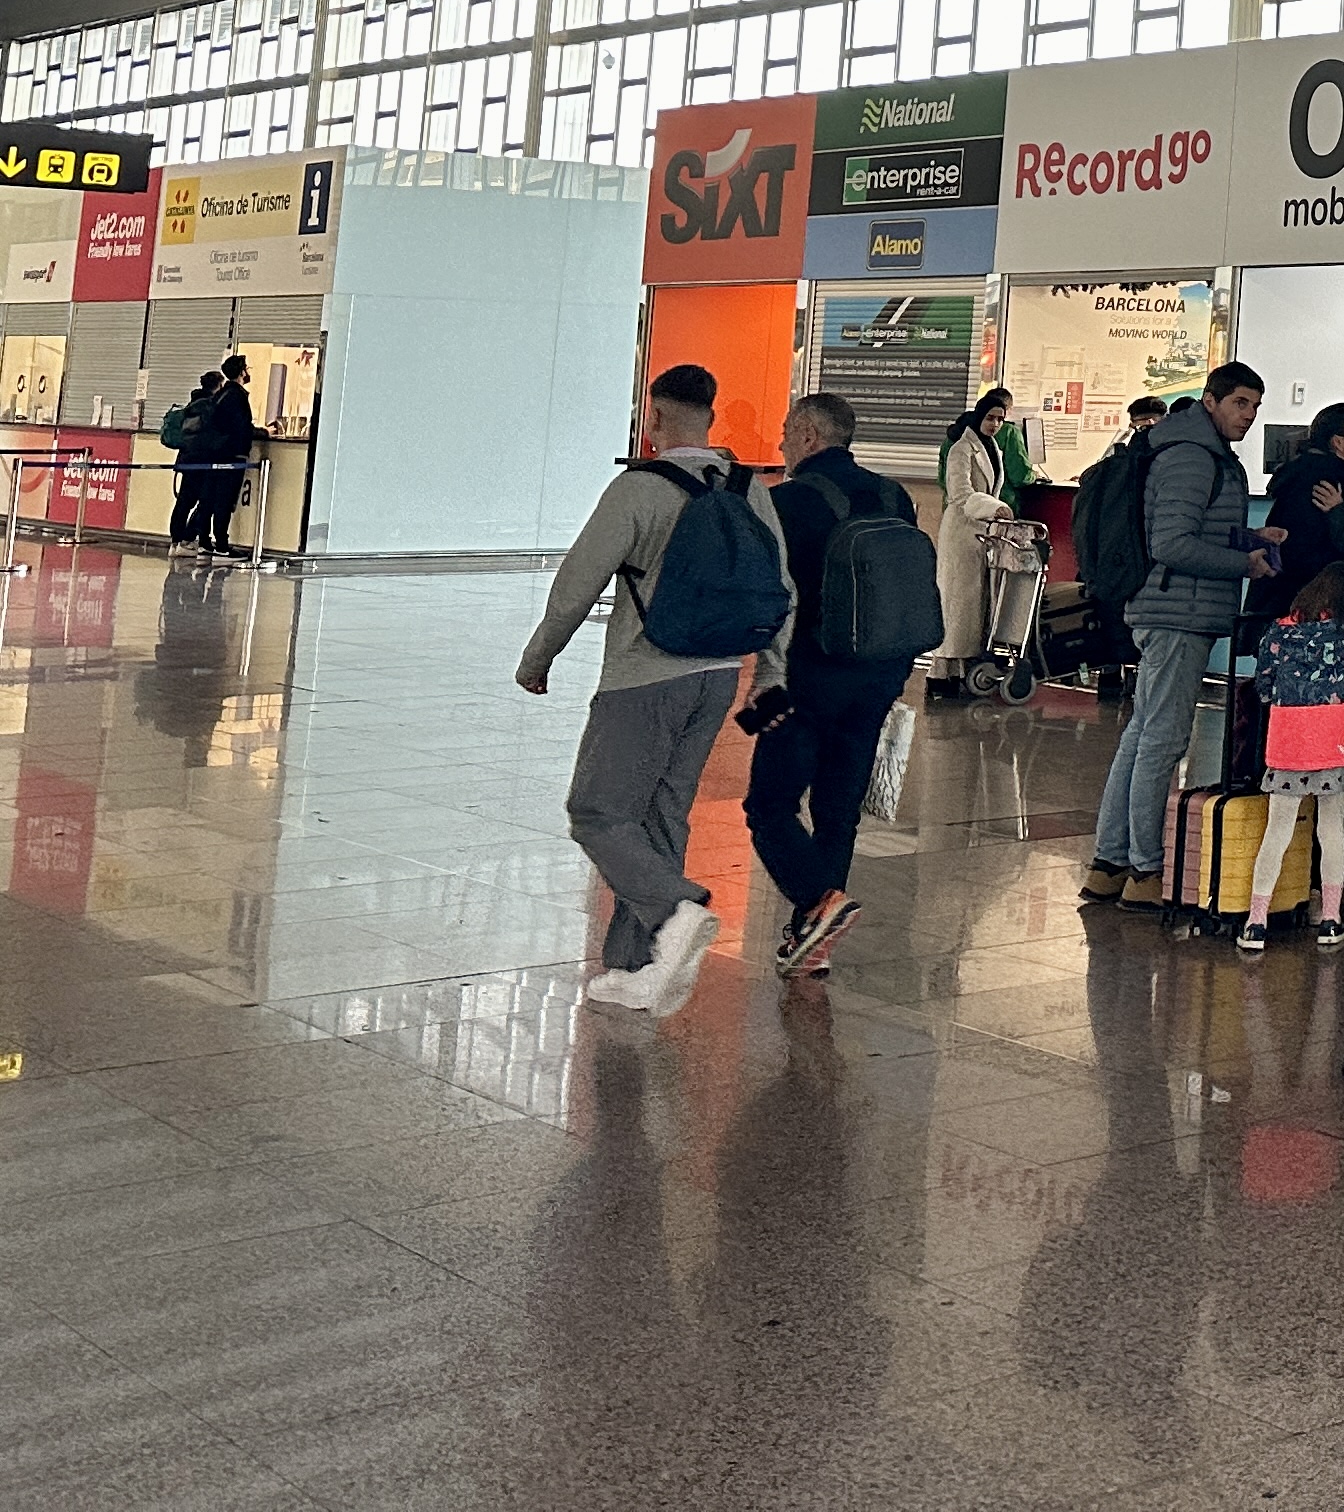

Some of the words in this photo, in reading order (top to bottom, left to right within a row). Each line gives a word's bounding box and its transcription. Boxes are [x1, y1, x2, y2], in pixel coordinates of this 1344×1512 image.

[880, 94, 955, 130] National
[848, 159, 961, 194] enterprise
[201, 196, 235, 218] Oficina
[236, 194, 250, 216] de
[251, 190, 292, 214] Turisme
[915, 185, 959, 197] rent-a-car
[870, 233, 922, 257] Alamo
[1095, 296, 1187, 314] BARCELONA
[1107, 327, 1150, 340] MOVING
[1151, 328, 1188, 341] WORLD
[63, 453, 119, 483] Jet.com
